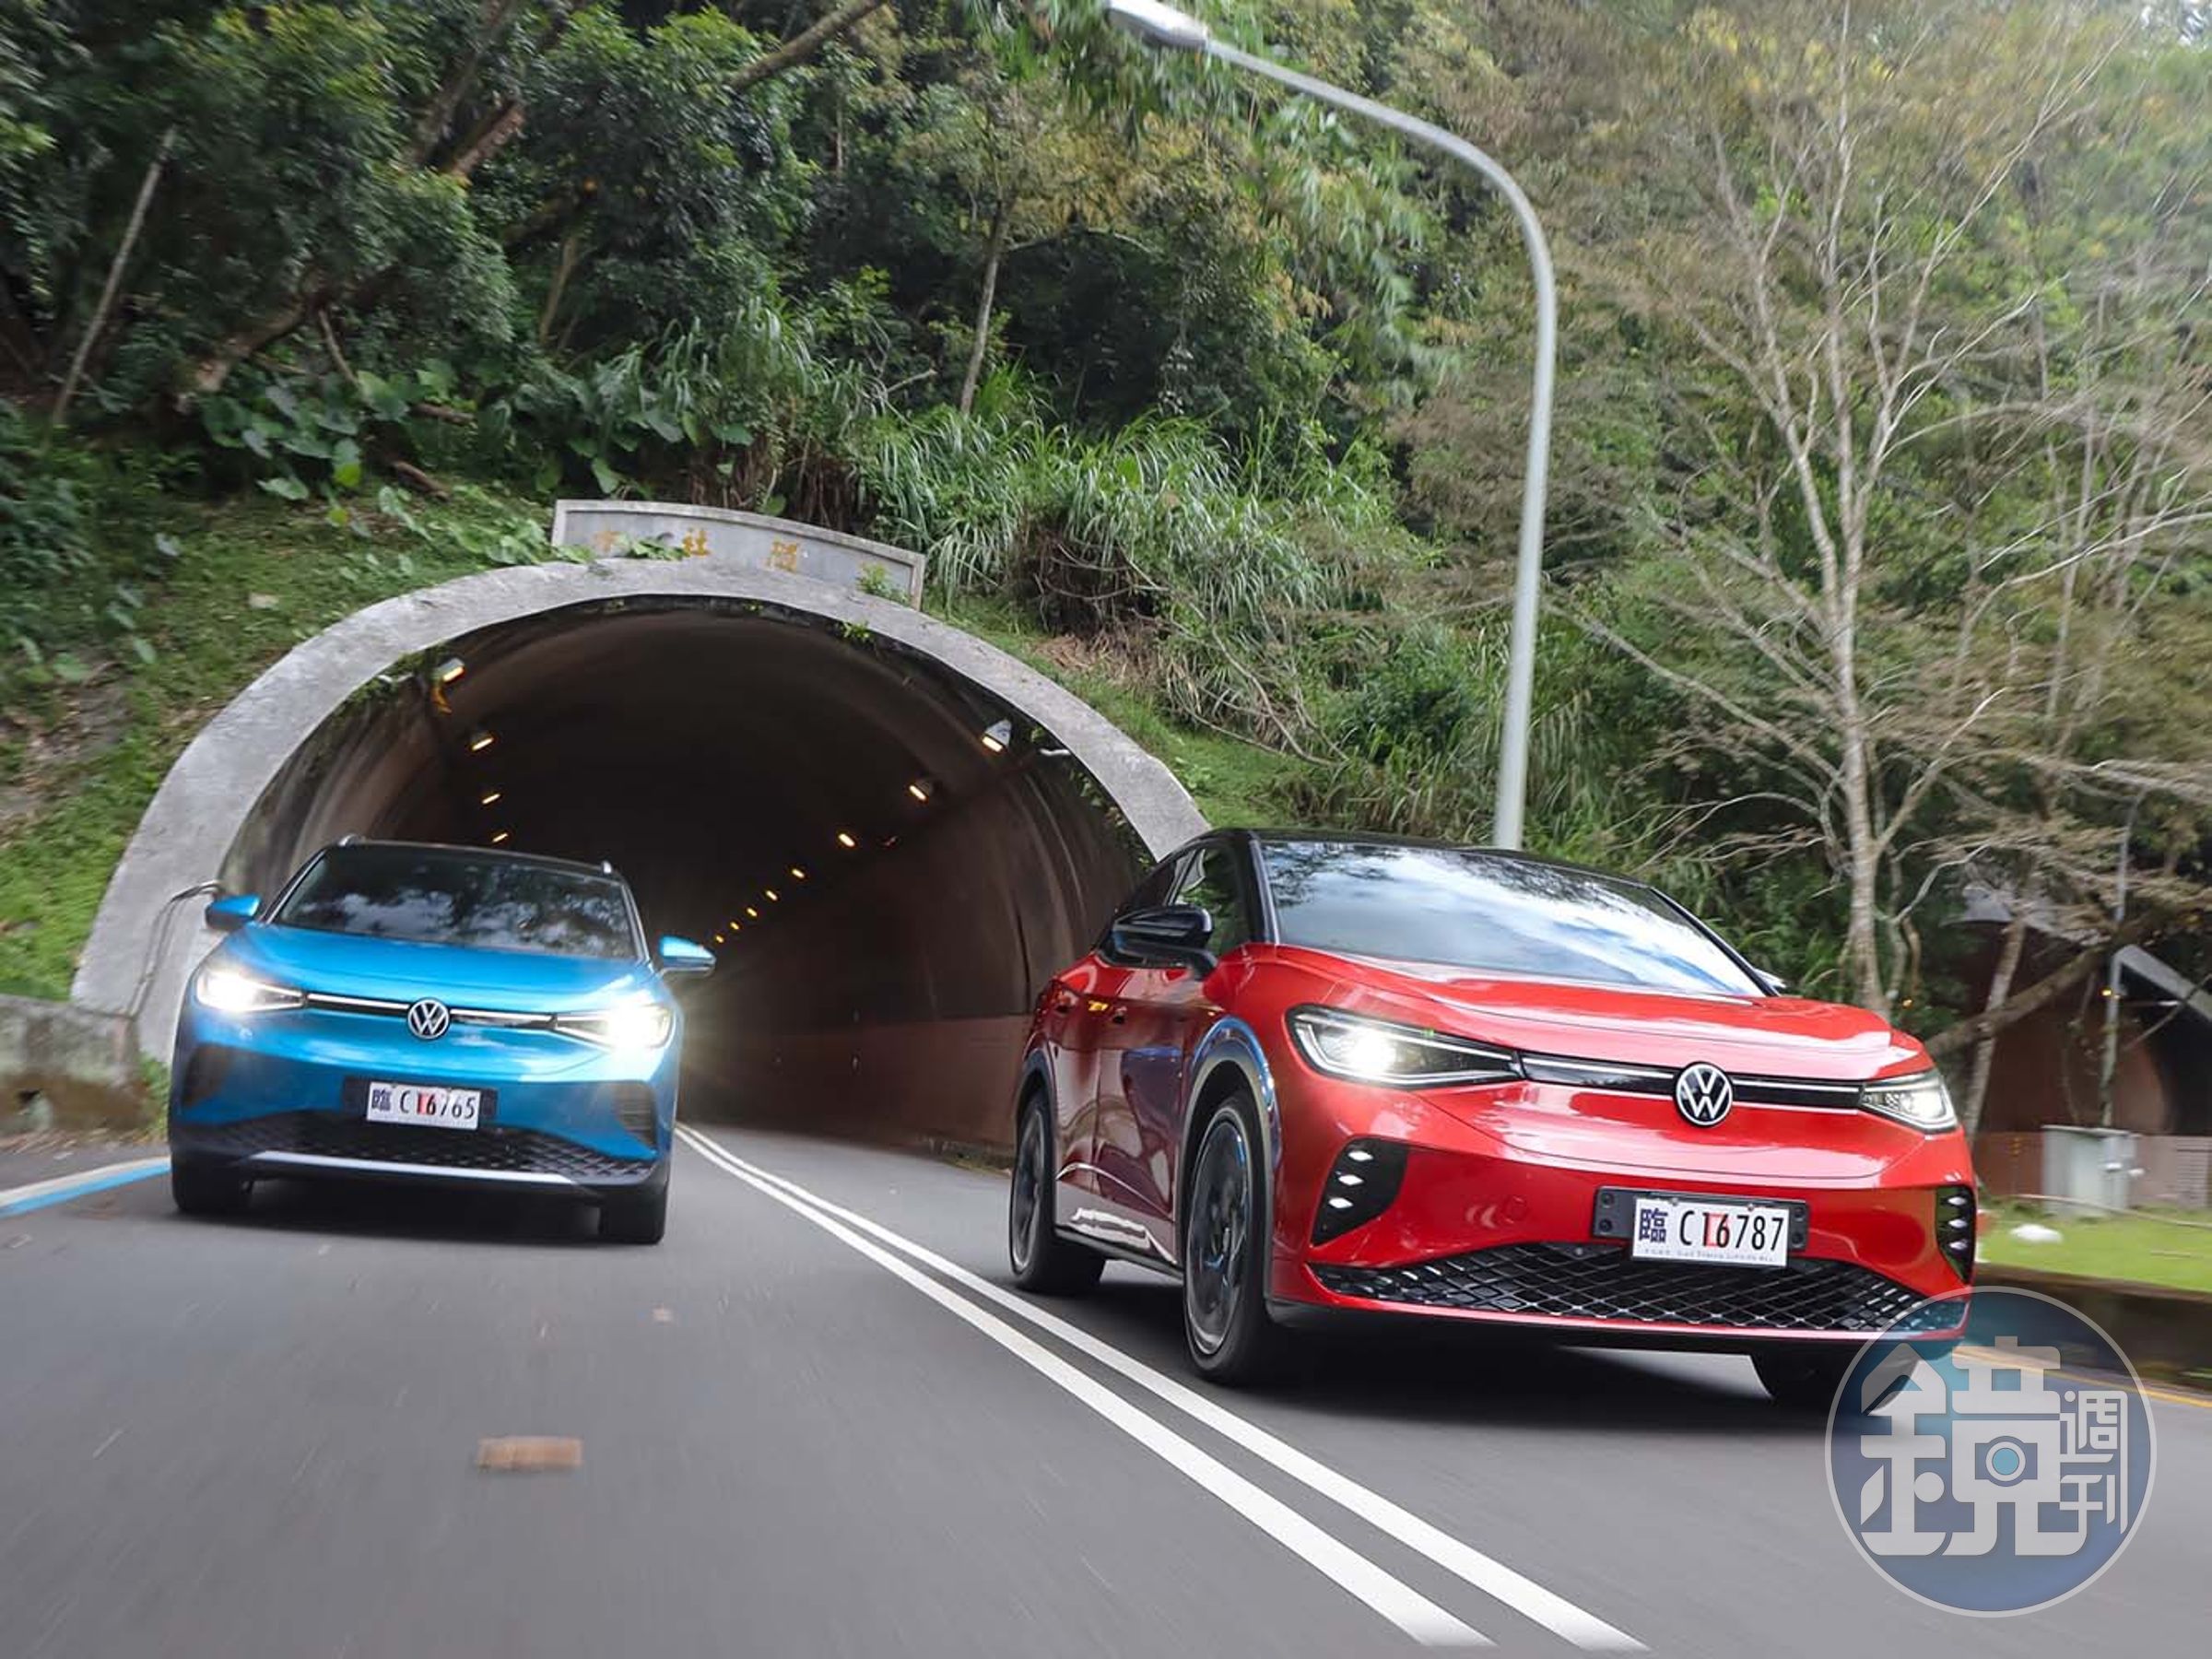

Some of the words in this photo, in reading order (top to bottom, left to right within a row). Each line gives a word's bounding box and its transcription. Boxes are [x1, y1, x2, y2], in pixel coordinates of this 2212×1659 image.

[1677, 1063, 1733, 1125] VW
[1638, 1207, 1668, 1243] 臨
[1678, 1210, 1784, 1252] C16787
